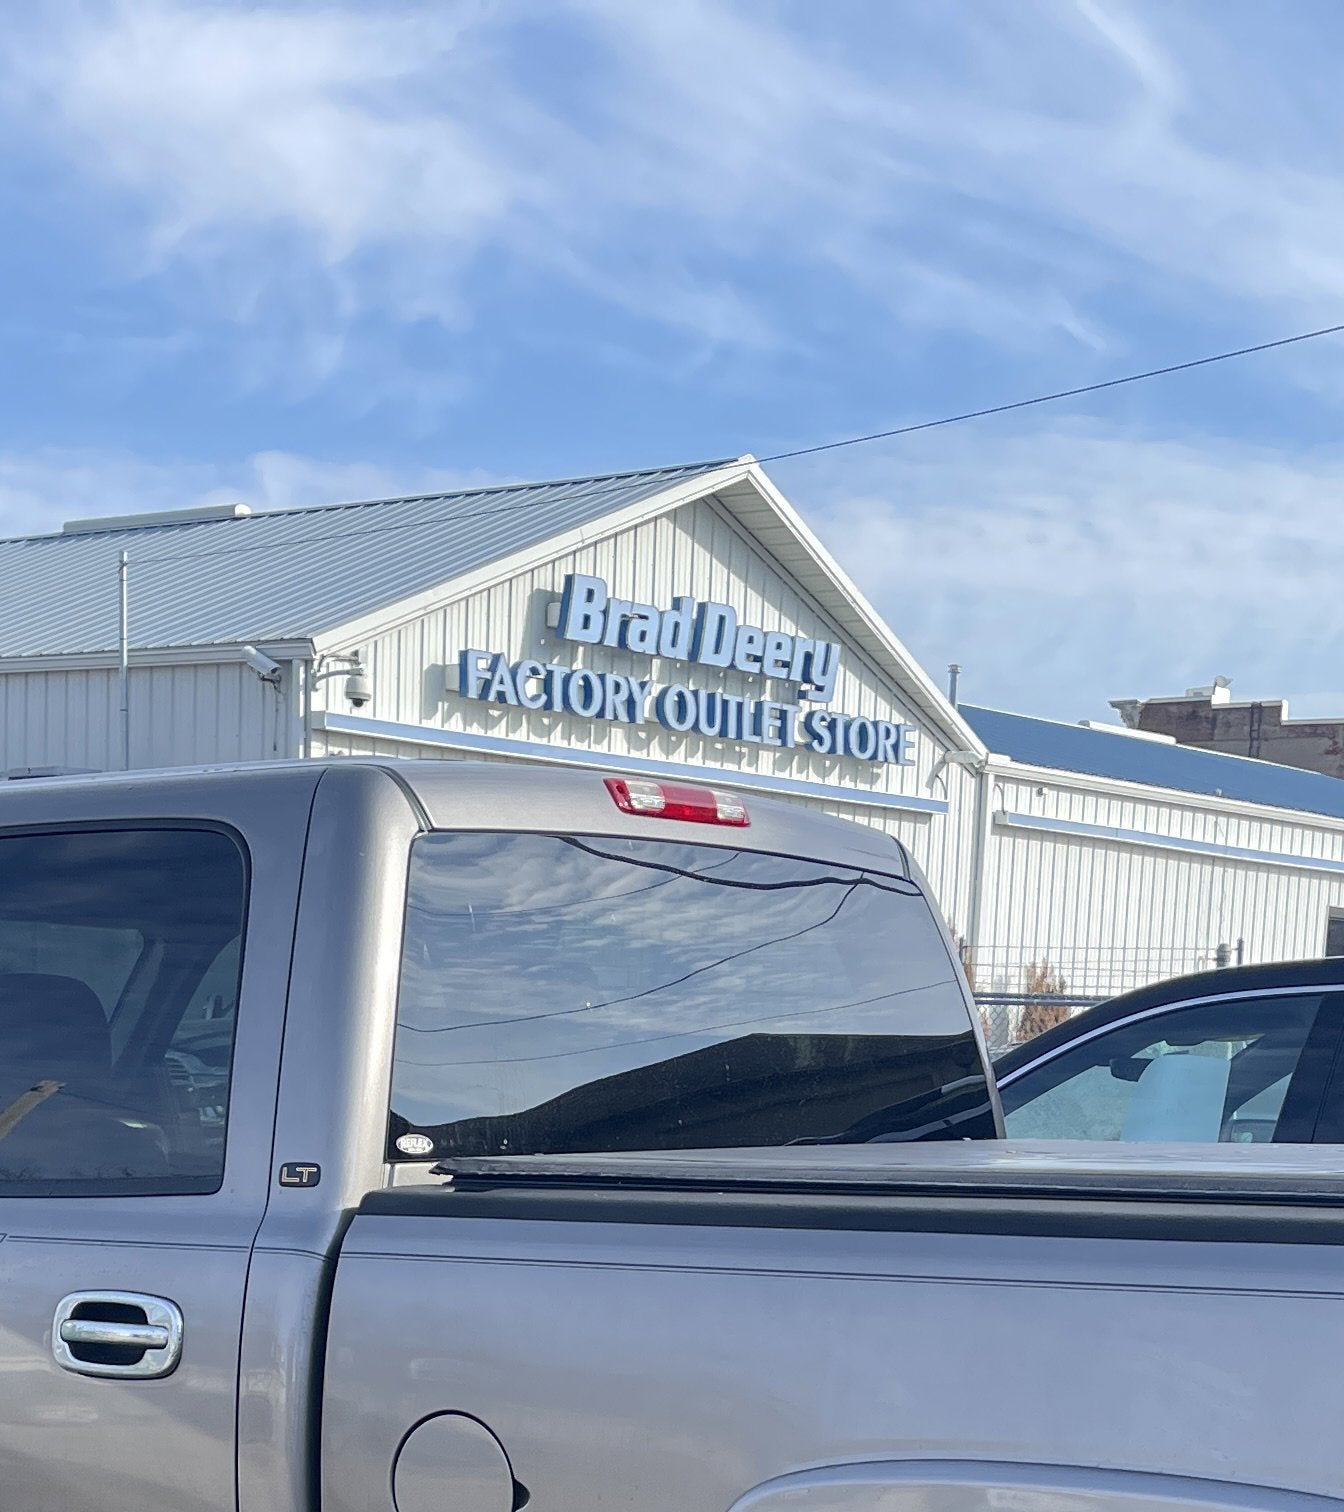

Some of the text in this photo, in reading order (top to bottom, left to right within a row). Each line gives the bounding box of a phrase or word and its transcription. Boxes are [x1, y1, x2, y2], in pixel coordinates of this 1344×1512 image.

[559, 572, 841, 704] Brad Deery
[460, 648, 916, 767] FACTORY OUTLET STORE
[281, 1167, 318, 1183] LT
